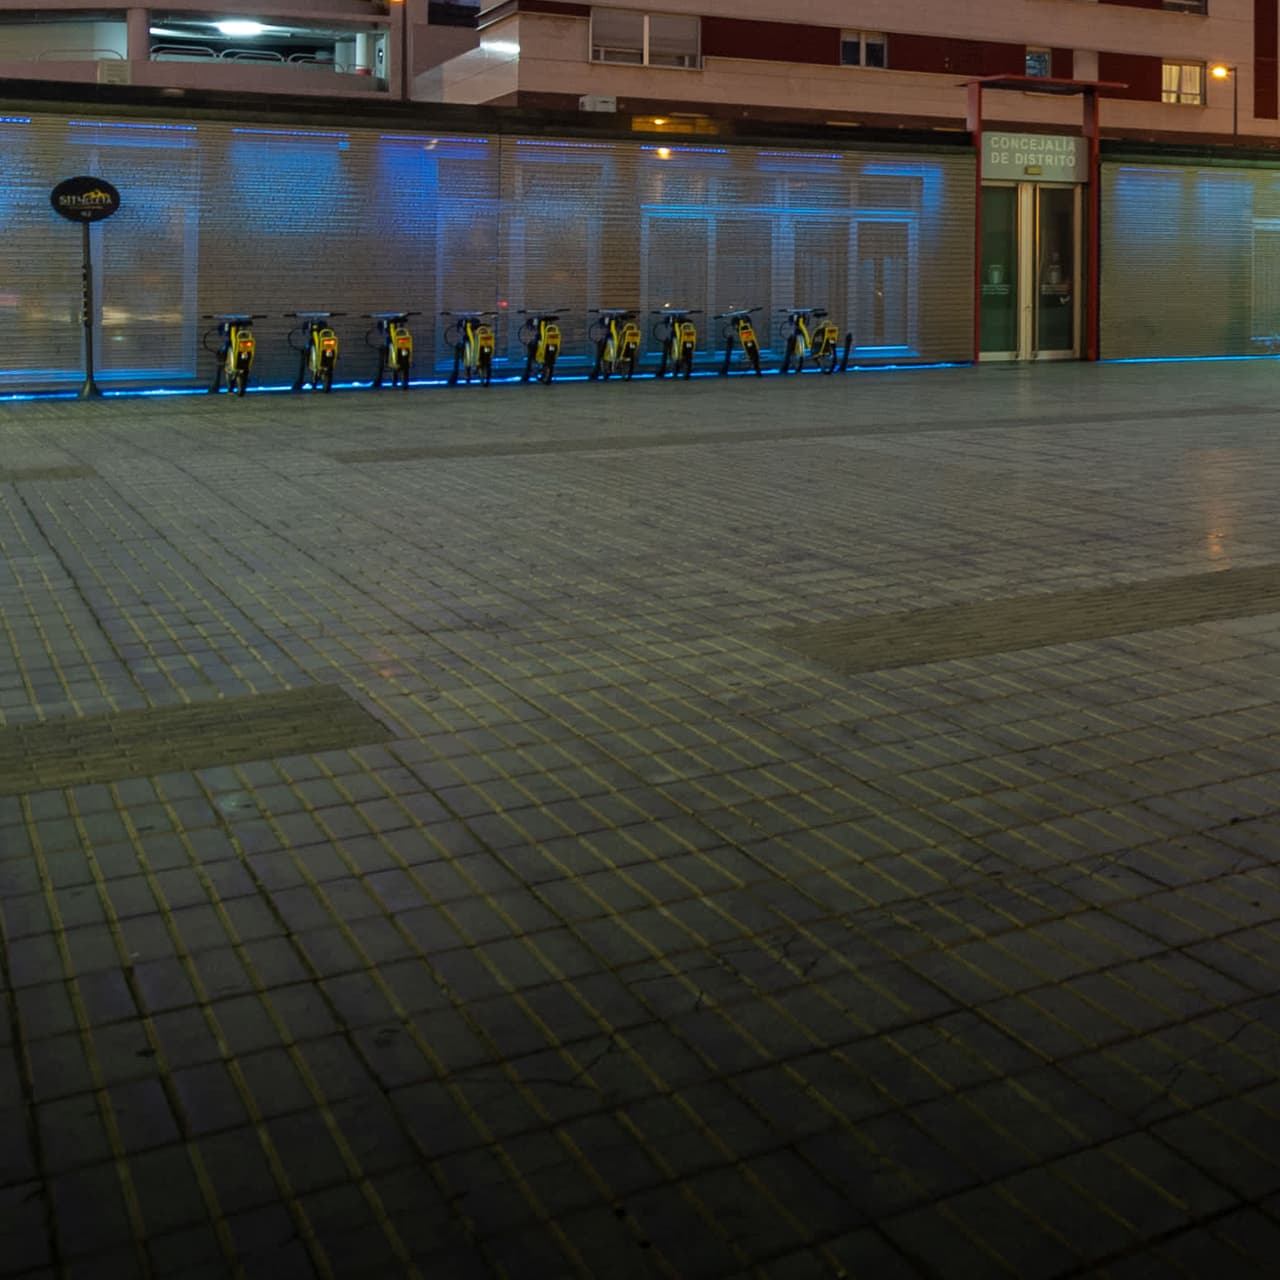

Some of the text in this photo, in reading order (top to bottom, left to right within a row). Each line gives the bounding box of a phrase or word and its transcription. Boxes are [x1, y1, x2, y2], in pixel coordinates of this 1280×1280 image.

[991, 136, 1076, 152] CONCEJALÍA
[991, 151, 1076, 167] DE DISTRITO
